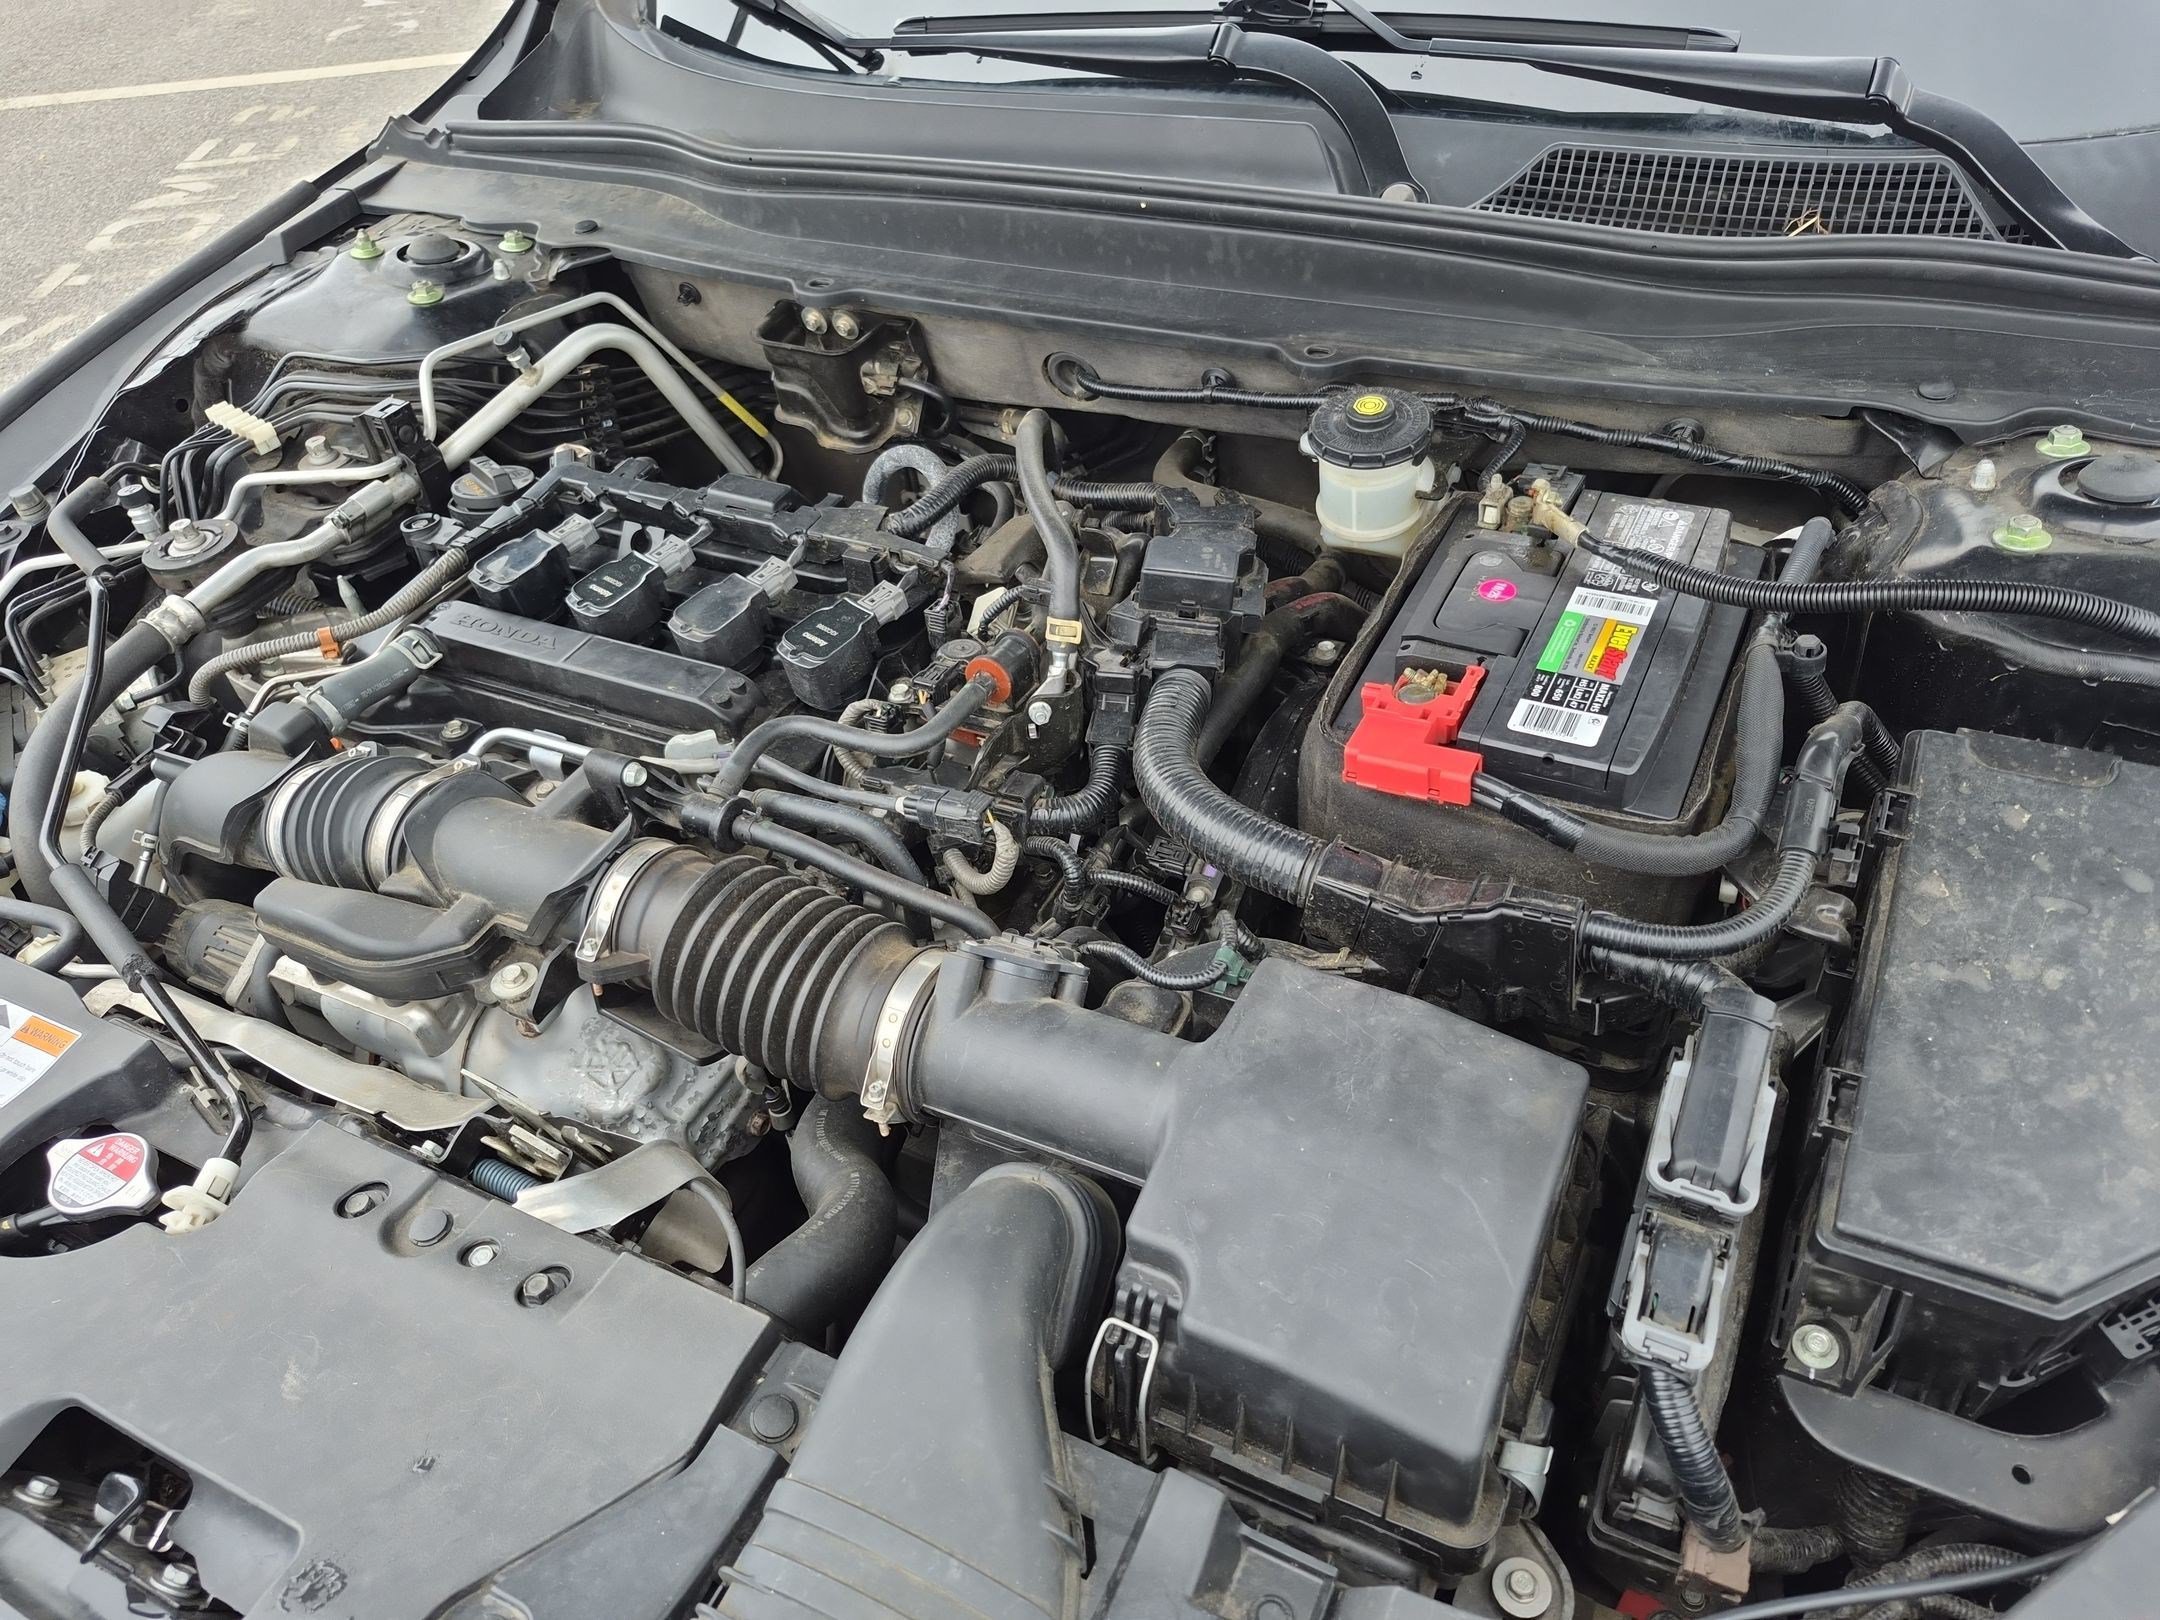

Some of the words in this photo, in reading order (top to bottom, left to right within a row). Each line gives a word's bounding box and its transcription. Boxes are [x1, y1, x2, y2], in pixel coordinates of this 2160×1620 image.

[450, 613, 556, 650] HONDA
[1587, 654, 1599, 670] MAXX
[1594, 624, 1639, 682] EverStart
[1530, 684, 1544, 697] 800
[1552, 689, 1564, 701] 650
[1594, 683, 1610, 703] MAXX
[1590, 702, 1602, 713] H5
[30, 1025, 68, 1049] WARNING
[109, 1143, 139, 1163] WARNING
[115, 1137, 141, 1155] DANGER
